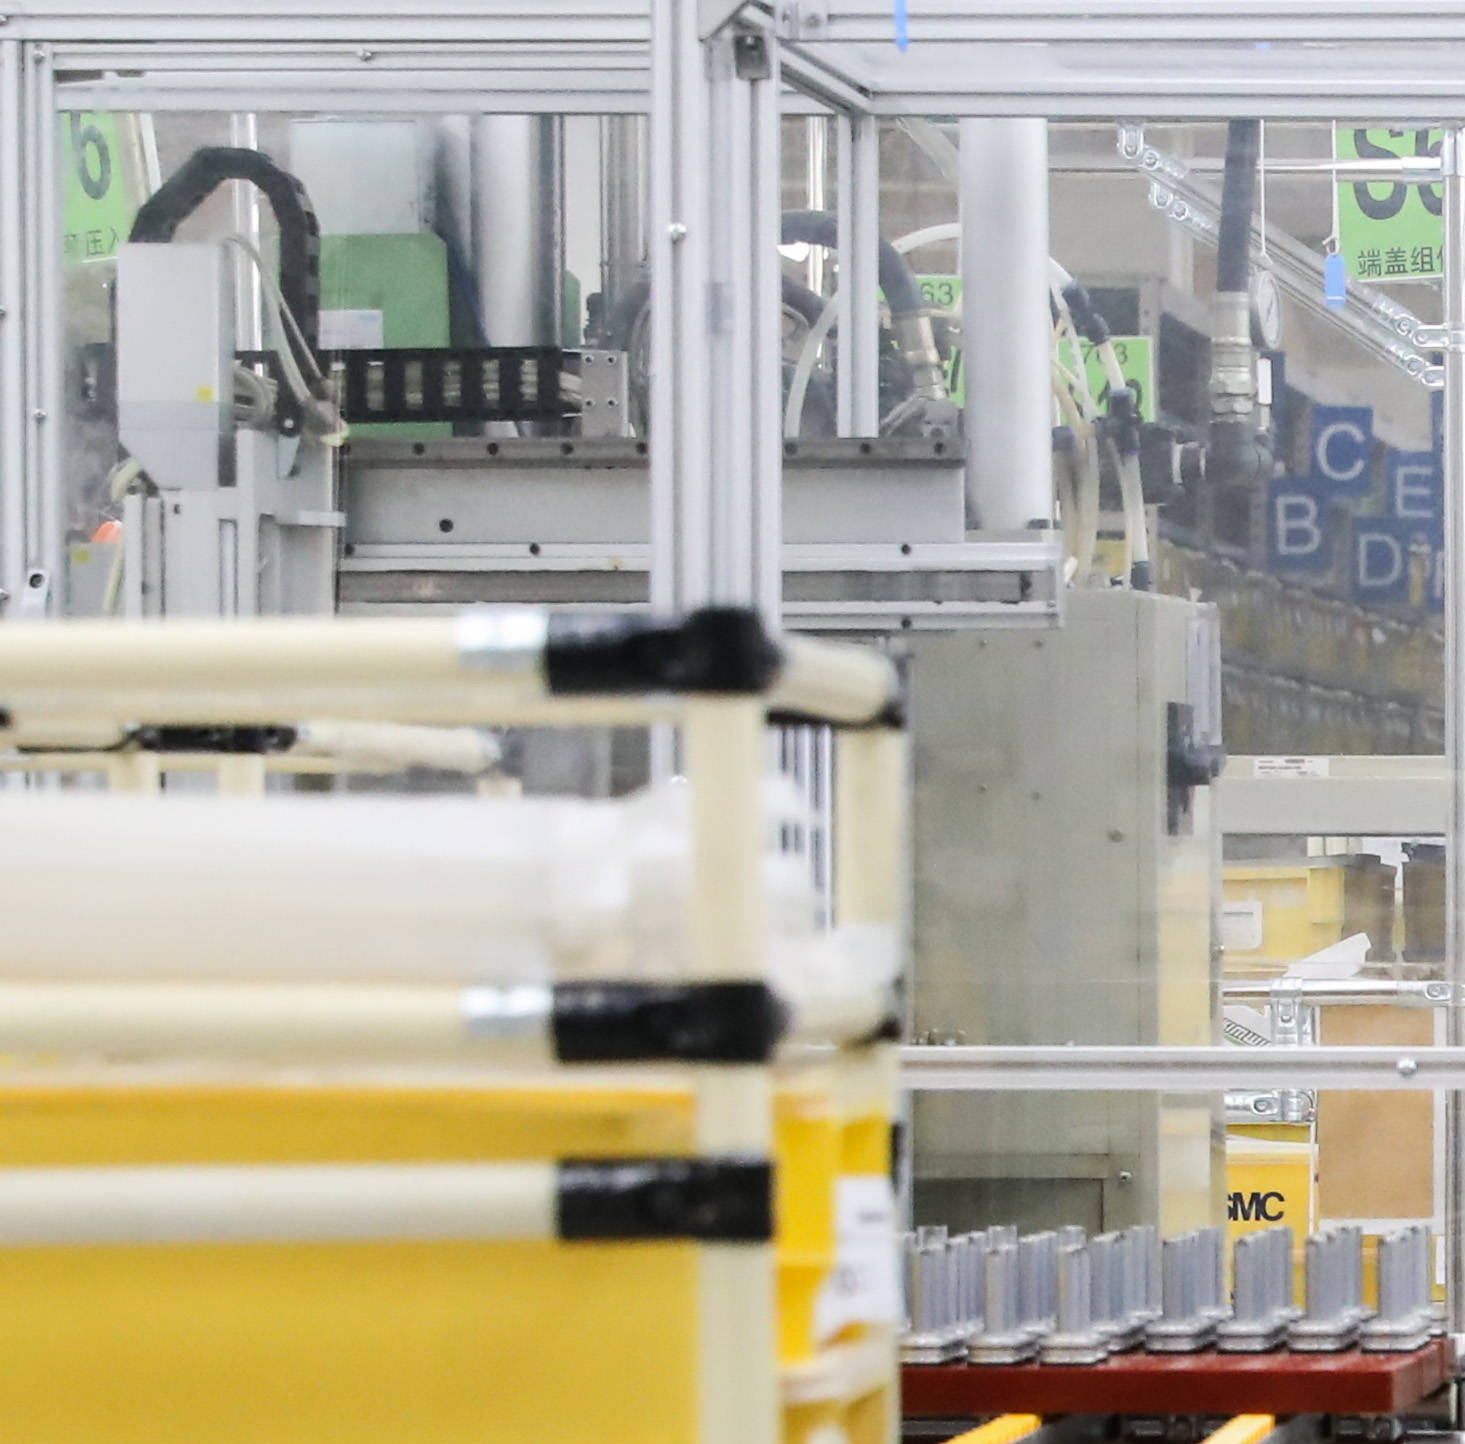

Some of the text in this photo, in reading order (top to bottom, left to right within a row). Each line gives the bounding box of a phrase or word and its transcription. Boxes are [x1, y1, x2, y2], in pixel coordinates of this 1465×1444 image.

[1357, 247, 1443, 276] 端盖组
[1317, 423, 1366, 481] C
[1397, 465, 1435, 519] E
[1276, 496, 1322, 556] B
[1358, 533, 1401, 588] D
